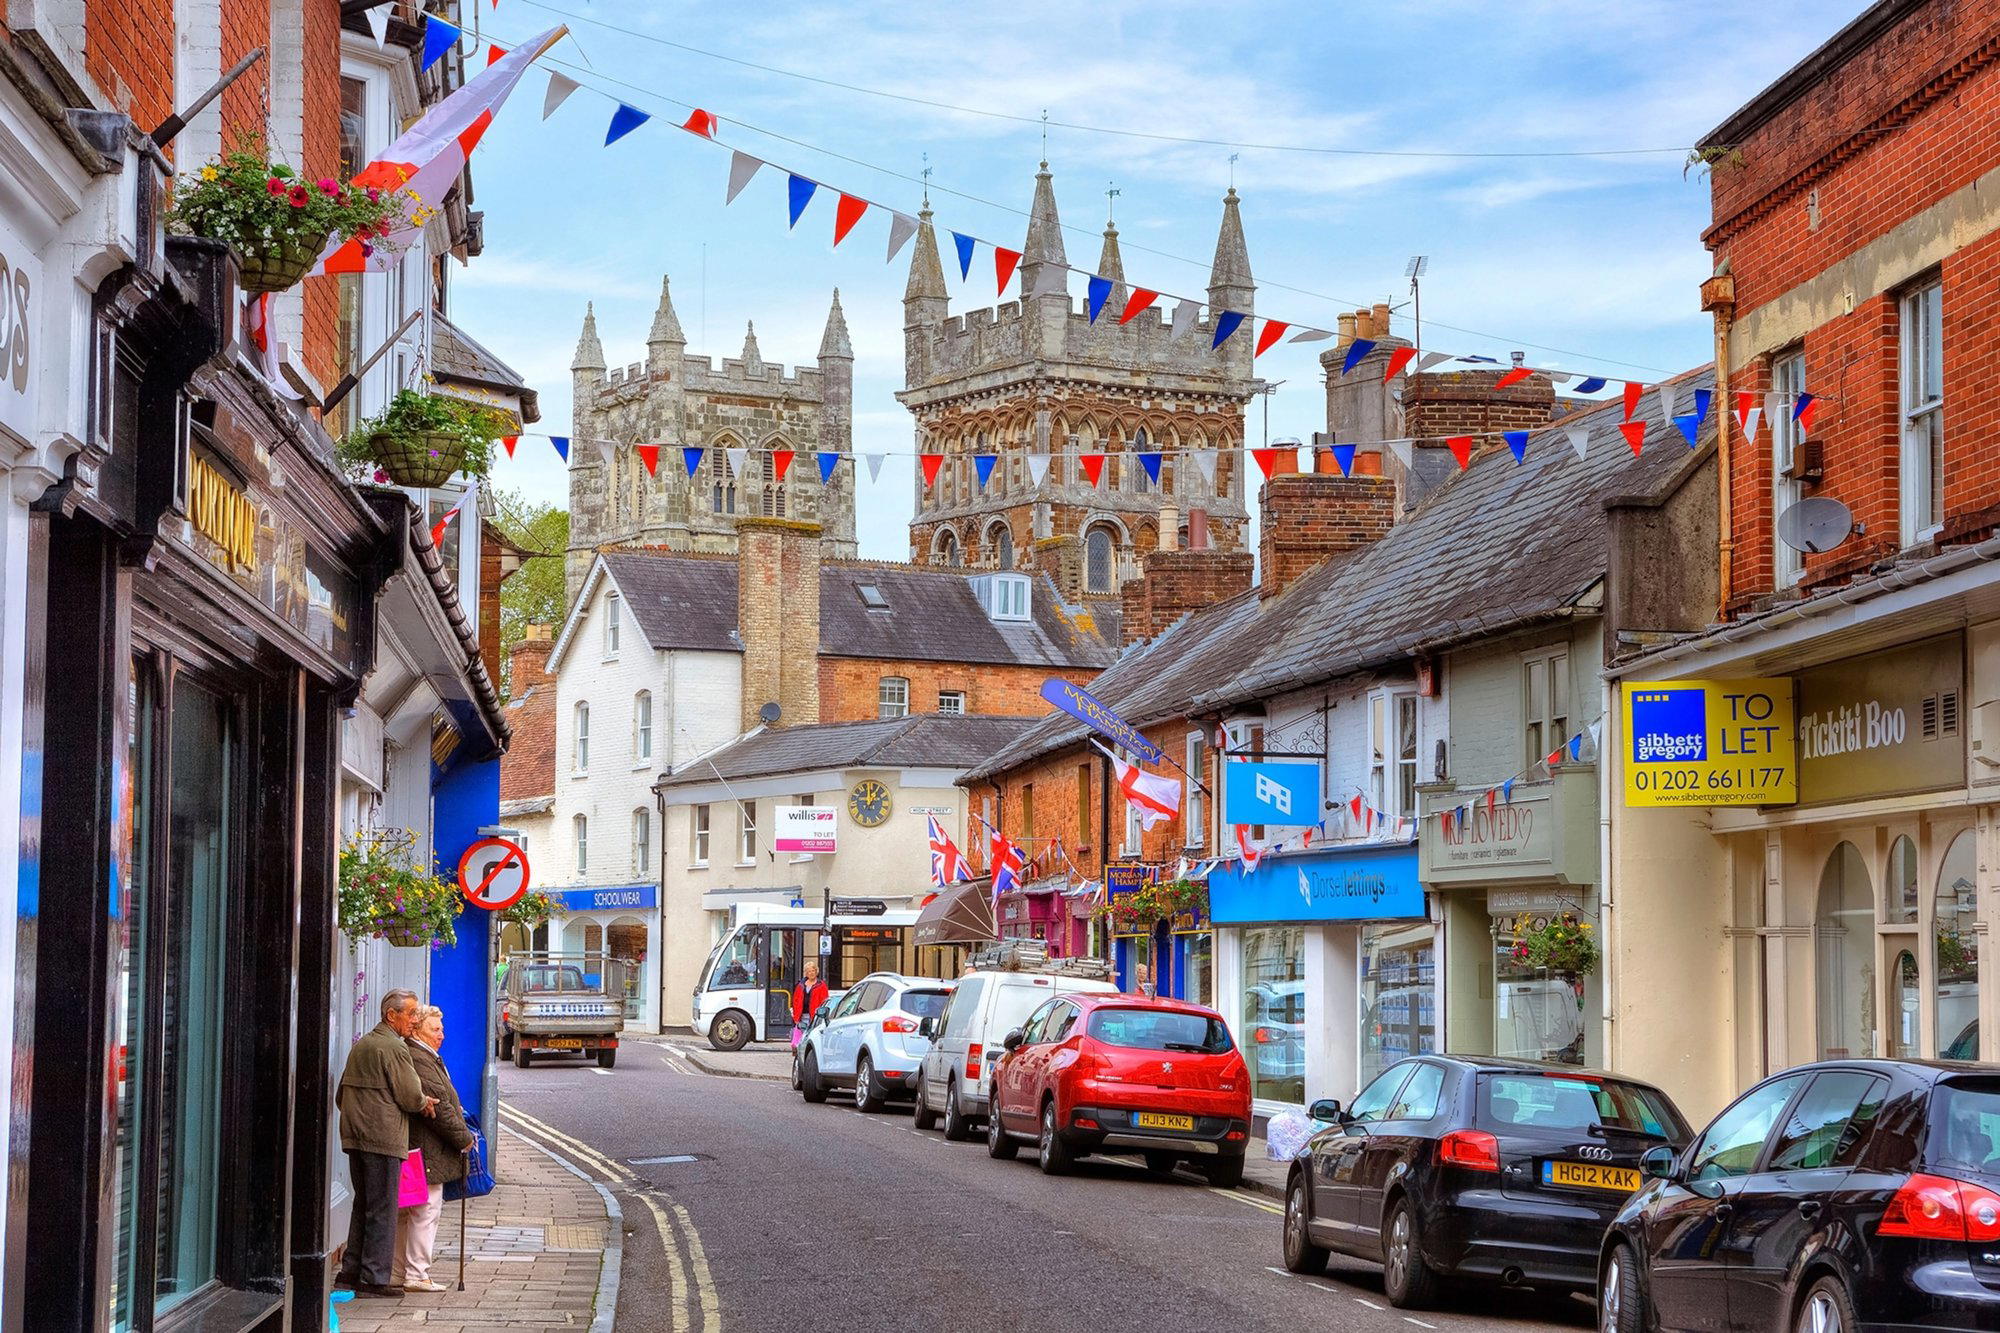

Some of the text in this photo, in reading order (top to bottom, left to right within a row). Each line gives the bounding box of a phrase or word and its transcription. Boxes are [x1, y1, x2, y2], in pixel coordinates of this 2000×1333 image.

[1063, 685, 1136, 739] MORGAN
[1722, 693, 1774, 721] TO
[1800, 700, 1906, 759] Tickiti Boo
[1638, 733, 1702, 747] sibbett
[1721, 726, 1780, 755] LET
[1638, 743, 1702, 761] gregory
[1635, 767, 1785, 790] 01202 661177
[1655, 792, 1766, 803] www.sibbettgregory.com
[789, 810, 816, 820] willis
[594, 891, 641, 906] SCHOOL WEAR
[1142, 1114, 1189, 1128] HJ13 KNZ
[1559, 1164, 1635, 1187] HG12 KAK
